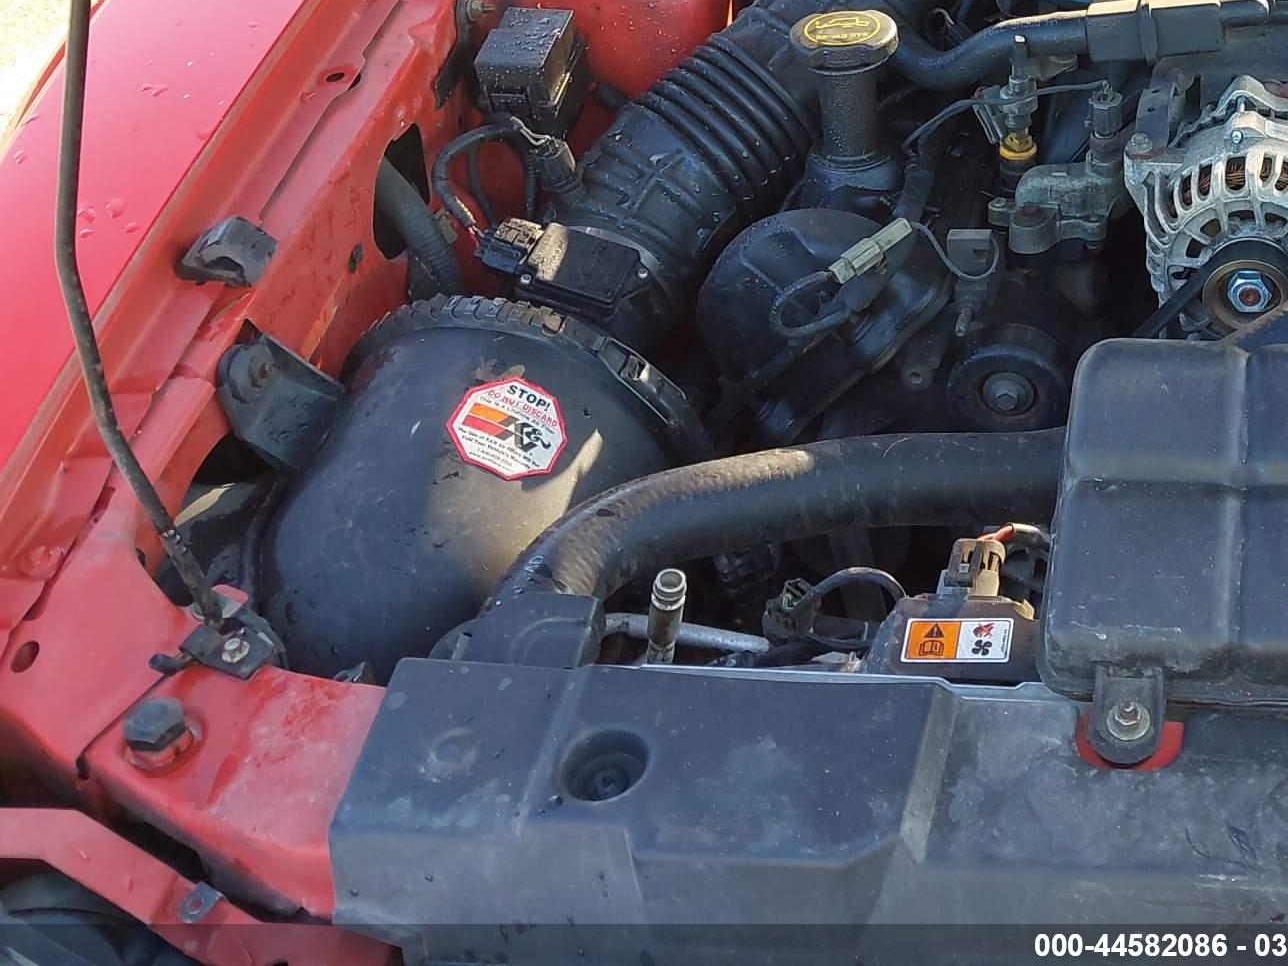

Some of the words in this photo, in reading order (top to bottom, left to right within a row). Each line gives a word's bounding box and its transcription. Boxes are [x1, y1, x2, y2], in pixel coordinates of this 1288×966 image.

[488, 389, 501, 398] DO
[502, 396, 520, 408] NOT
[522, 403, 558, 427] DISCARD
[507, 384, 551, 412] STOP!
[532, 418, 540, 426] Air
